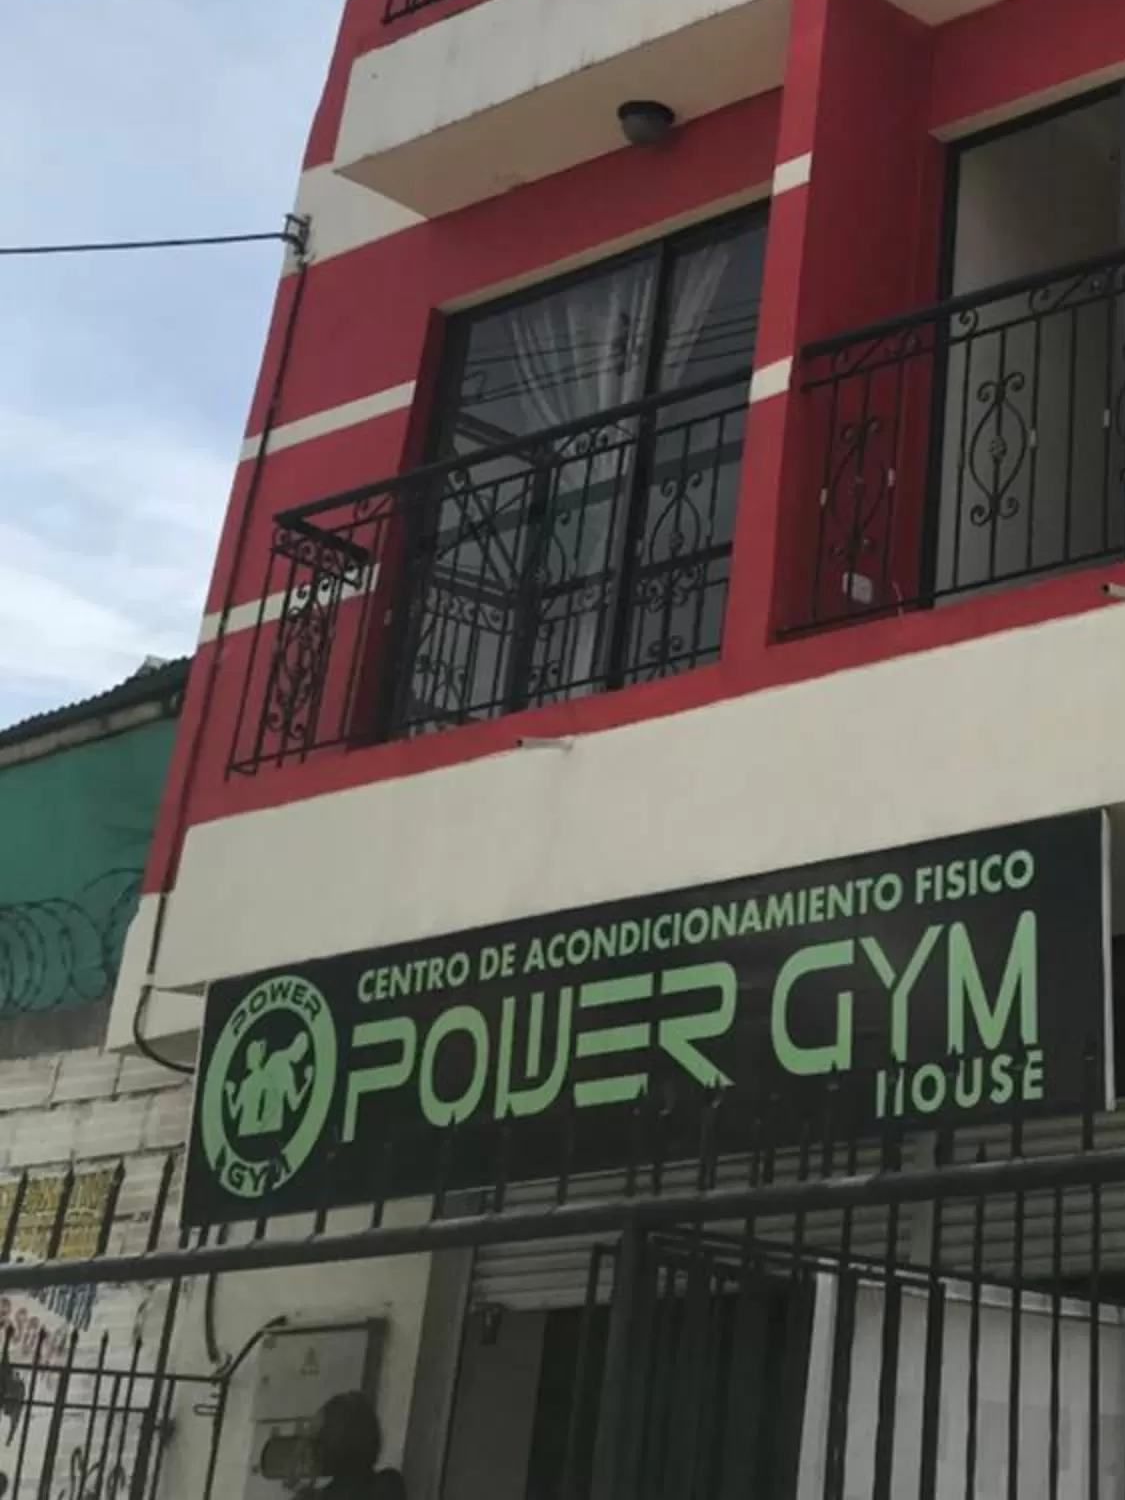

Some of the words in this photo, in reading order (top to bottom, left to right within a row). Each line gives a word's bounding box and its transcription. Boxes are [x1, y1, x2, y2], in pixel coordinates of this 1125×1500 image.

[357, 952, 471, 1003] CENTRO
[479, 941, 517, 981] DE
[523, 873, 903, 974] ACONDICIONAMIENTO
[915, 849, 1036, 905] FISICO
[231, 979, 321, 1036] POWER
[342, 961, 736, 1143] POWER
[771, 909, 1038, 1076] GYM
[875, 1049, 1045, 1119] HOUSE
